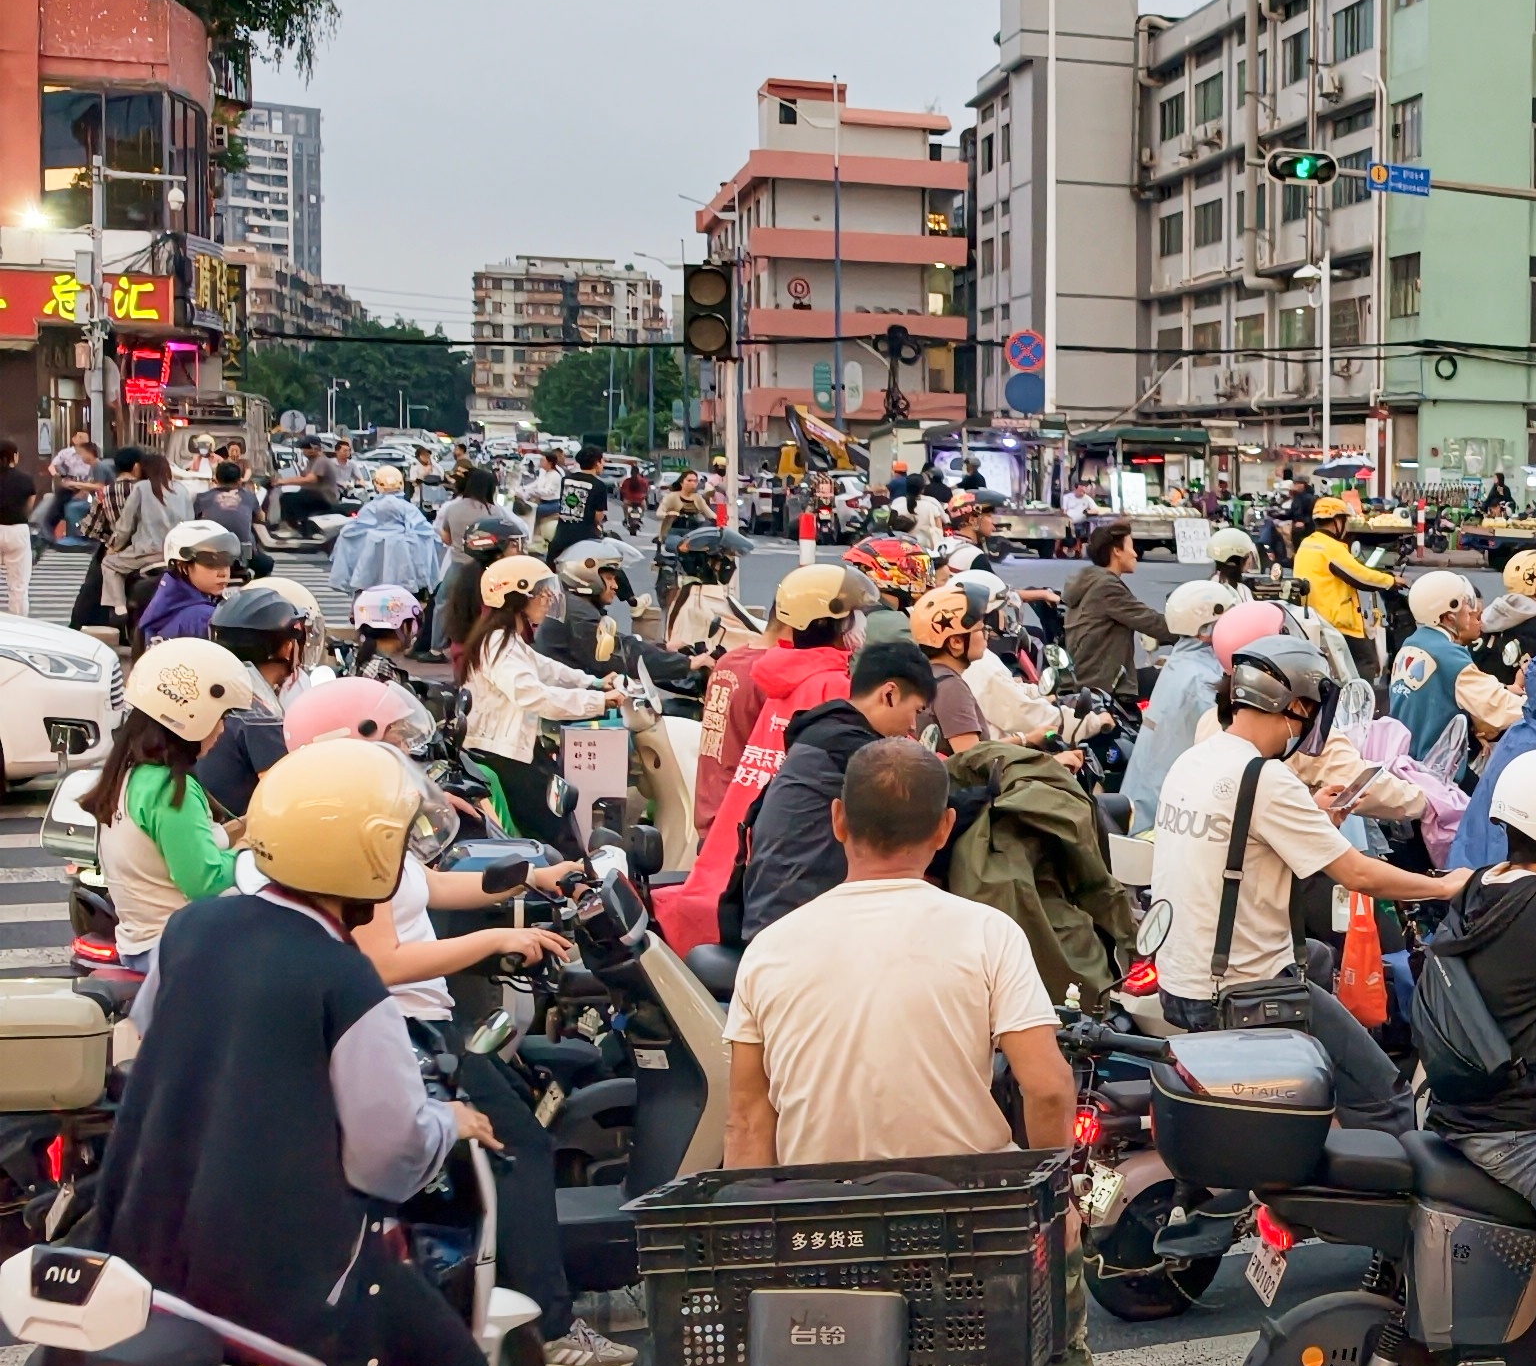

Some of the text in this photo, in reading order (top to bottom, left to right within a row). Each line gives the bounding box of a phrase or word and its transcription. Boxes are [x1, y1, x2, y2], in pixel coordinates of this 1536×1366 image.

[791, 1230, 864, 1251] 多多货运
[790, 1325, 846, 1345] 台铃
